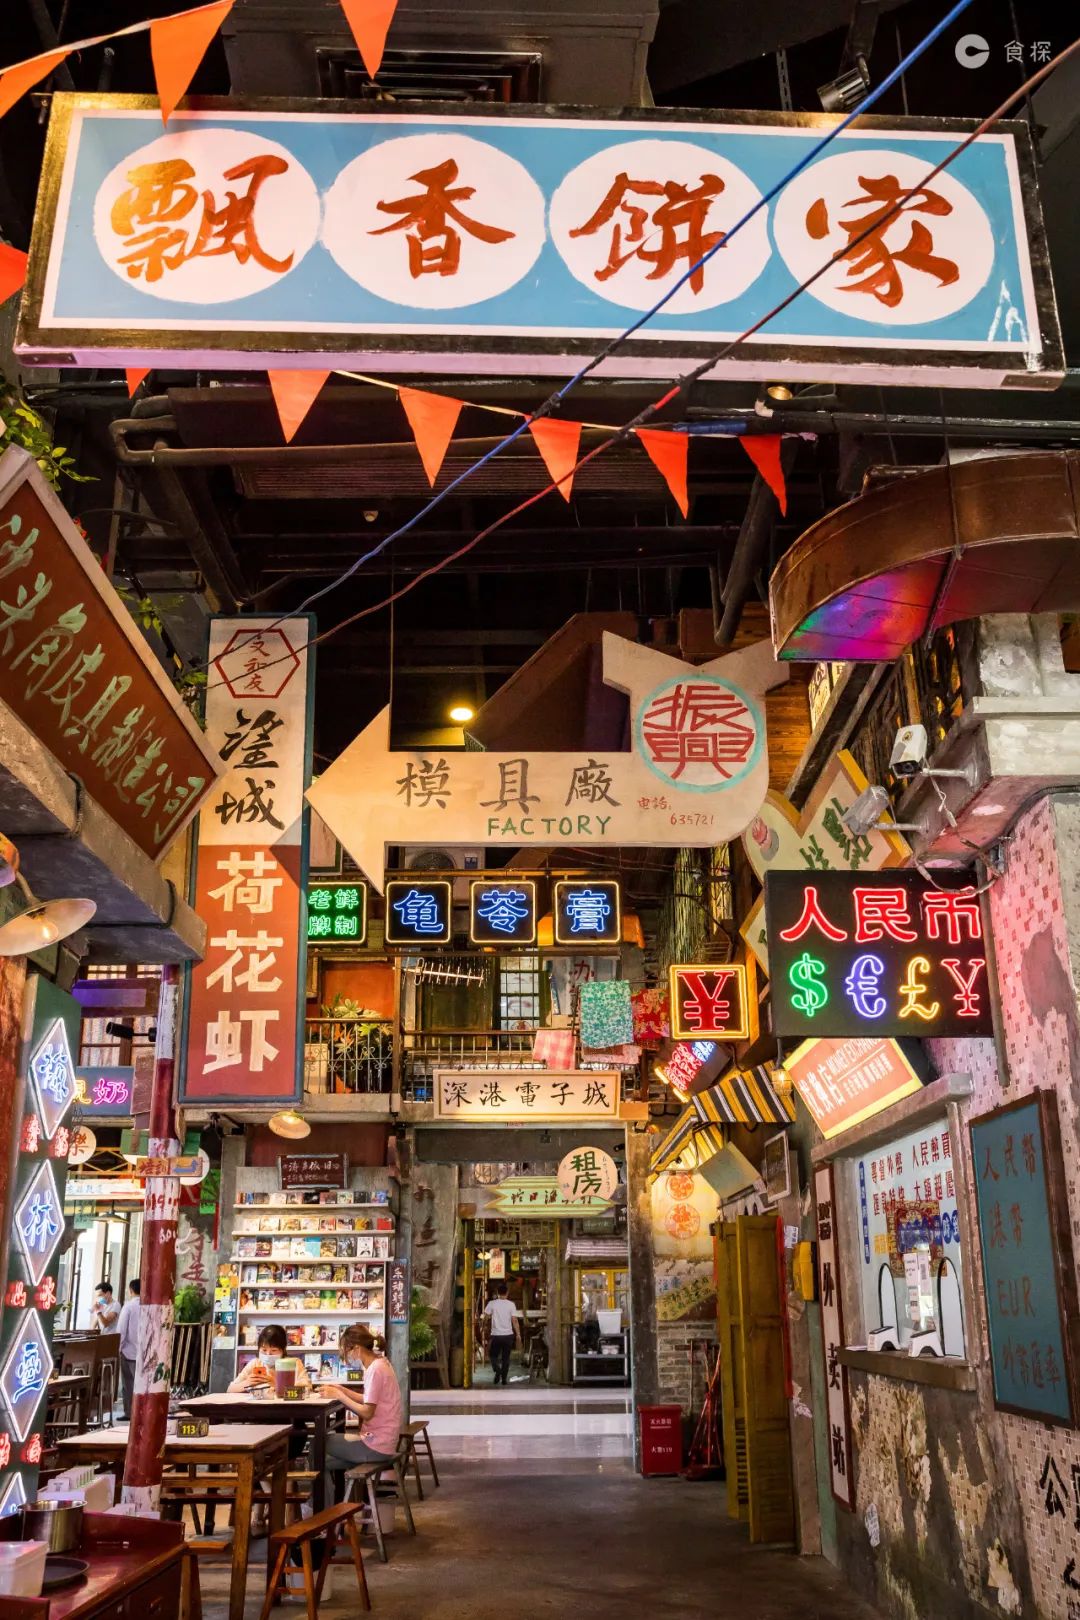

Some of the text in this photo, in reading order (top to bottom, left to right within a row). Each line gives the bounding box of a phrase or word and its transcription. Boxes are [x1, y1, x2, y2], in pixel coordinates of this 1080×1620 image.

[110, 154, 959, 308] 飄香餅家
[244, 636, 270, 692] 文和友
[397, 758, 620, 812] 模具廠
[488, 818, 611, 837] FACTORY
[670, 813, 714, 826] 635721
[779, 886, 982, 945] 人民币
[202, 851, 284, 1075] 荷花虾
[443, 1081, 611, 1108] 深港電子城
[570, 1151, 602, 1195] 租房
[182, 1425, 196, 1435] 113
